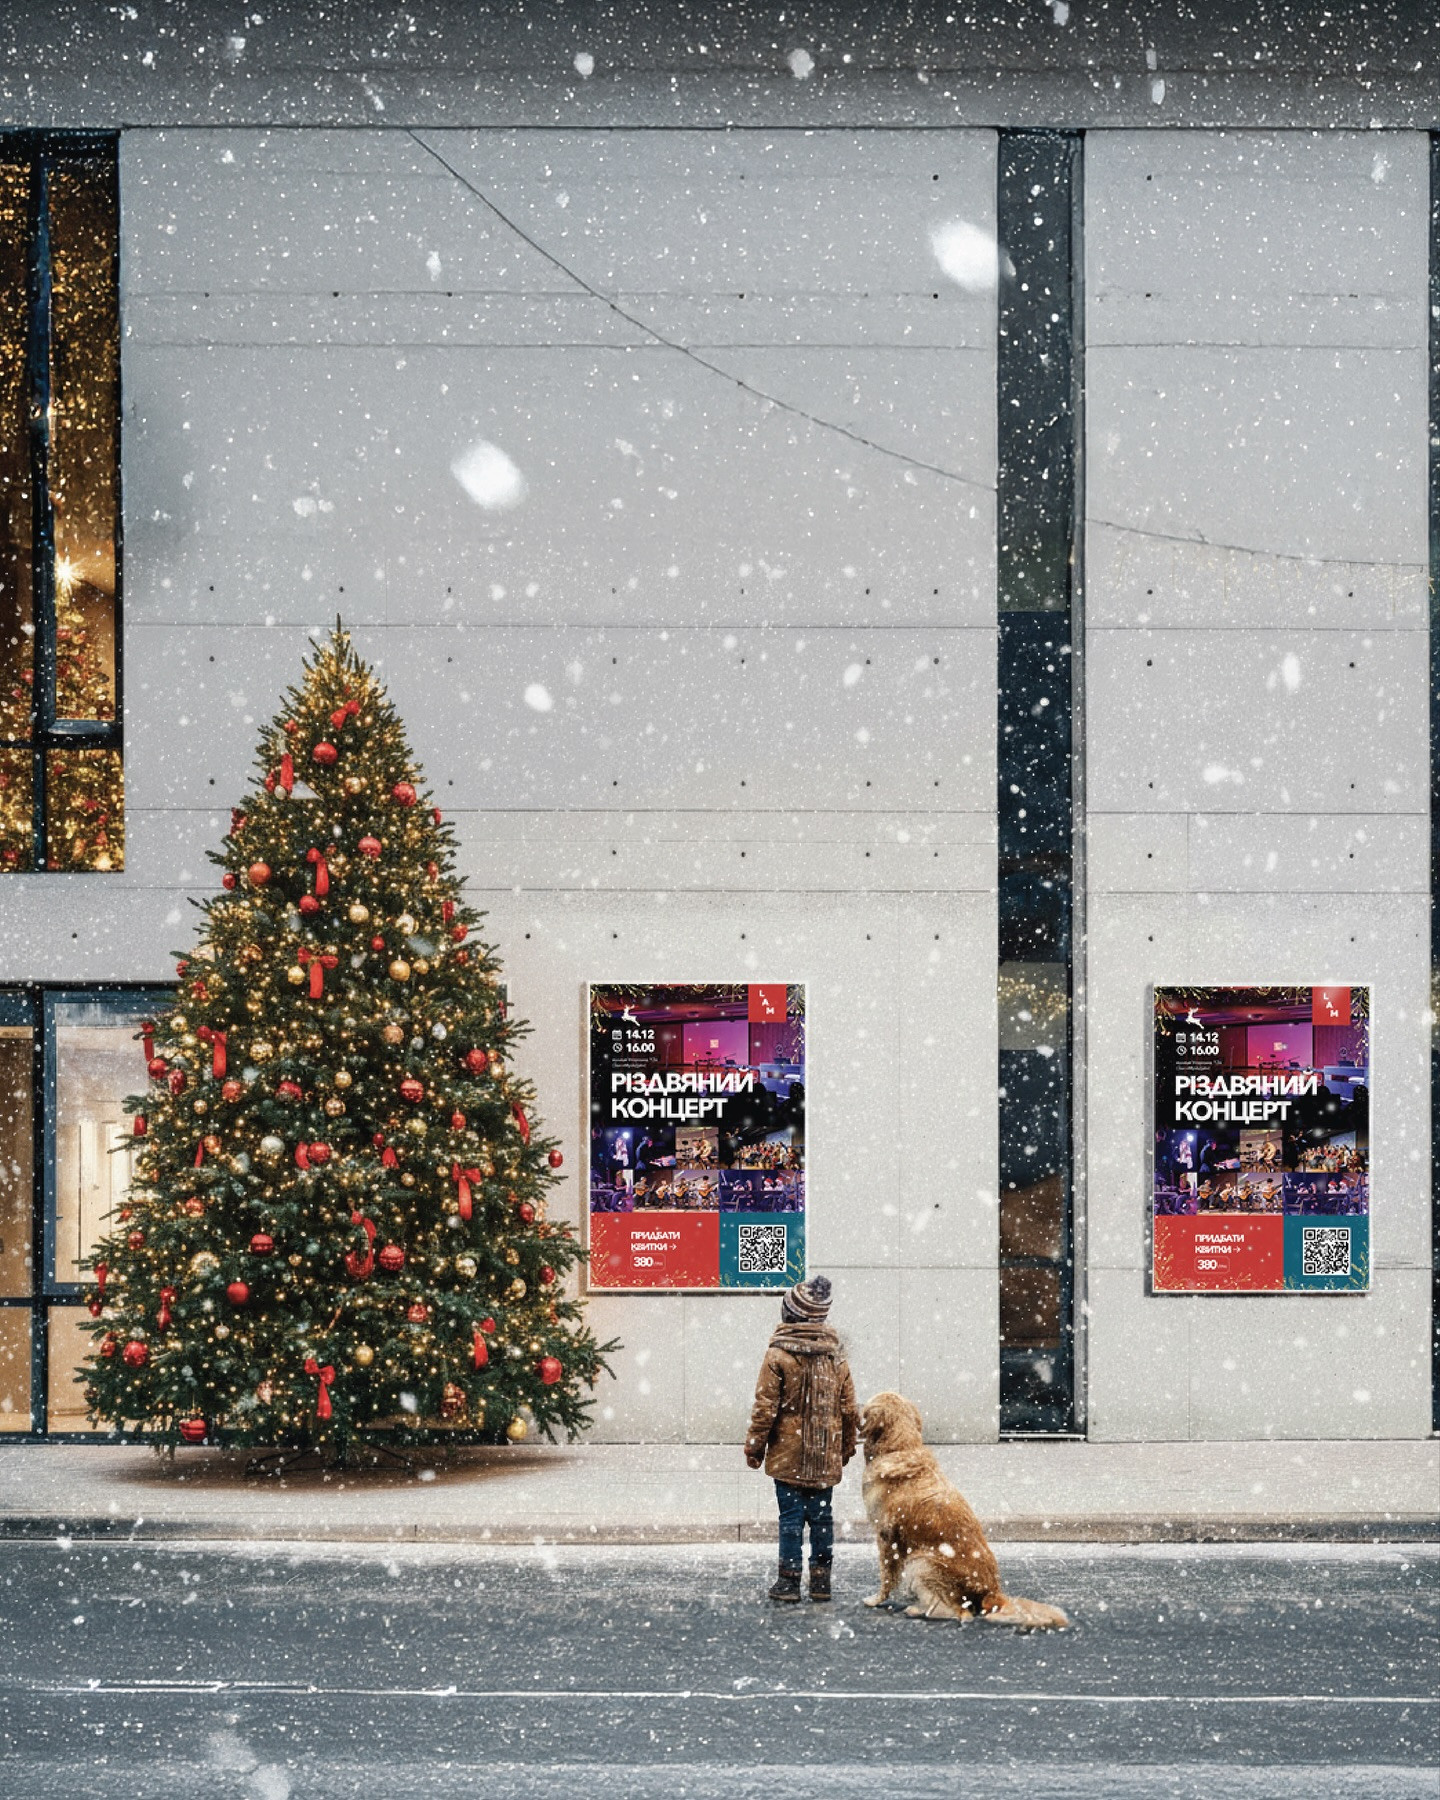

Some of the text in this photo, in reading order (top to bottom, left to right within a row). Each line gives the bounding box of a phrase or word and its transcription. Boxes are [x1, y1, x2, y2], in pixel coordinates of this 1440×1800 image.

[759, 989, 775, 1015] LAM
[626, 1029, 655, 1040] 14.12
[1190, 1032, 1219, 1042] 14.12
[626, 1042, 655, 1053] 16.00
[1190, 1045, 1219, 1055] 16.00
[611, 1067, 753, 1096] РІЗДВЯНИЙ
[1175, 1069, 1318, 1098] РІЗДВЯНИЙ
[611, 1098, 728, 1122] КОНЦЕРТ
[1175, 1101, 1292, 1124] КОНЦЕРТ
[630, 1231, 681, 1241] ПРИДБАТИ
[1194, 1234, 1245, 1243] ПРИДБАТИ
[630, 1243, 668, 1251] КВИТКИ
[1194, 1245, 1232, 1254] КВИТКИ
[633, 1256, 654, 1267] 380
[1197, 1259, 1218, 1270] 380
